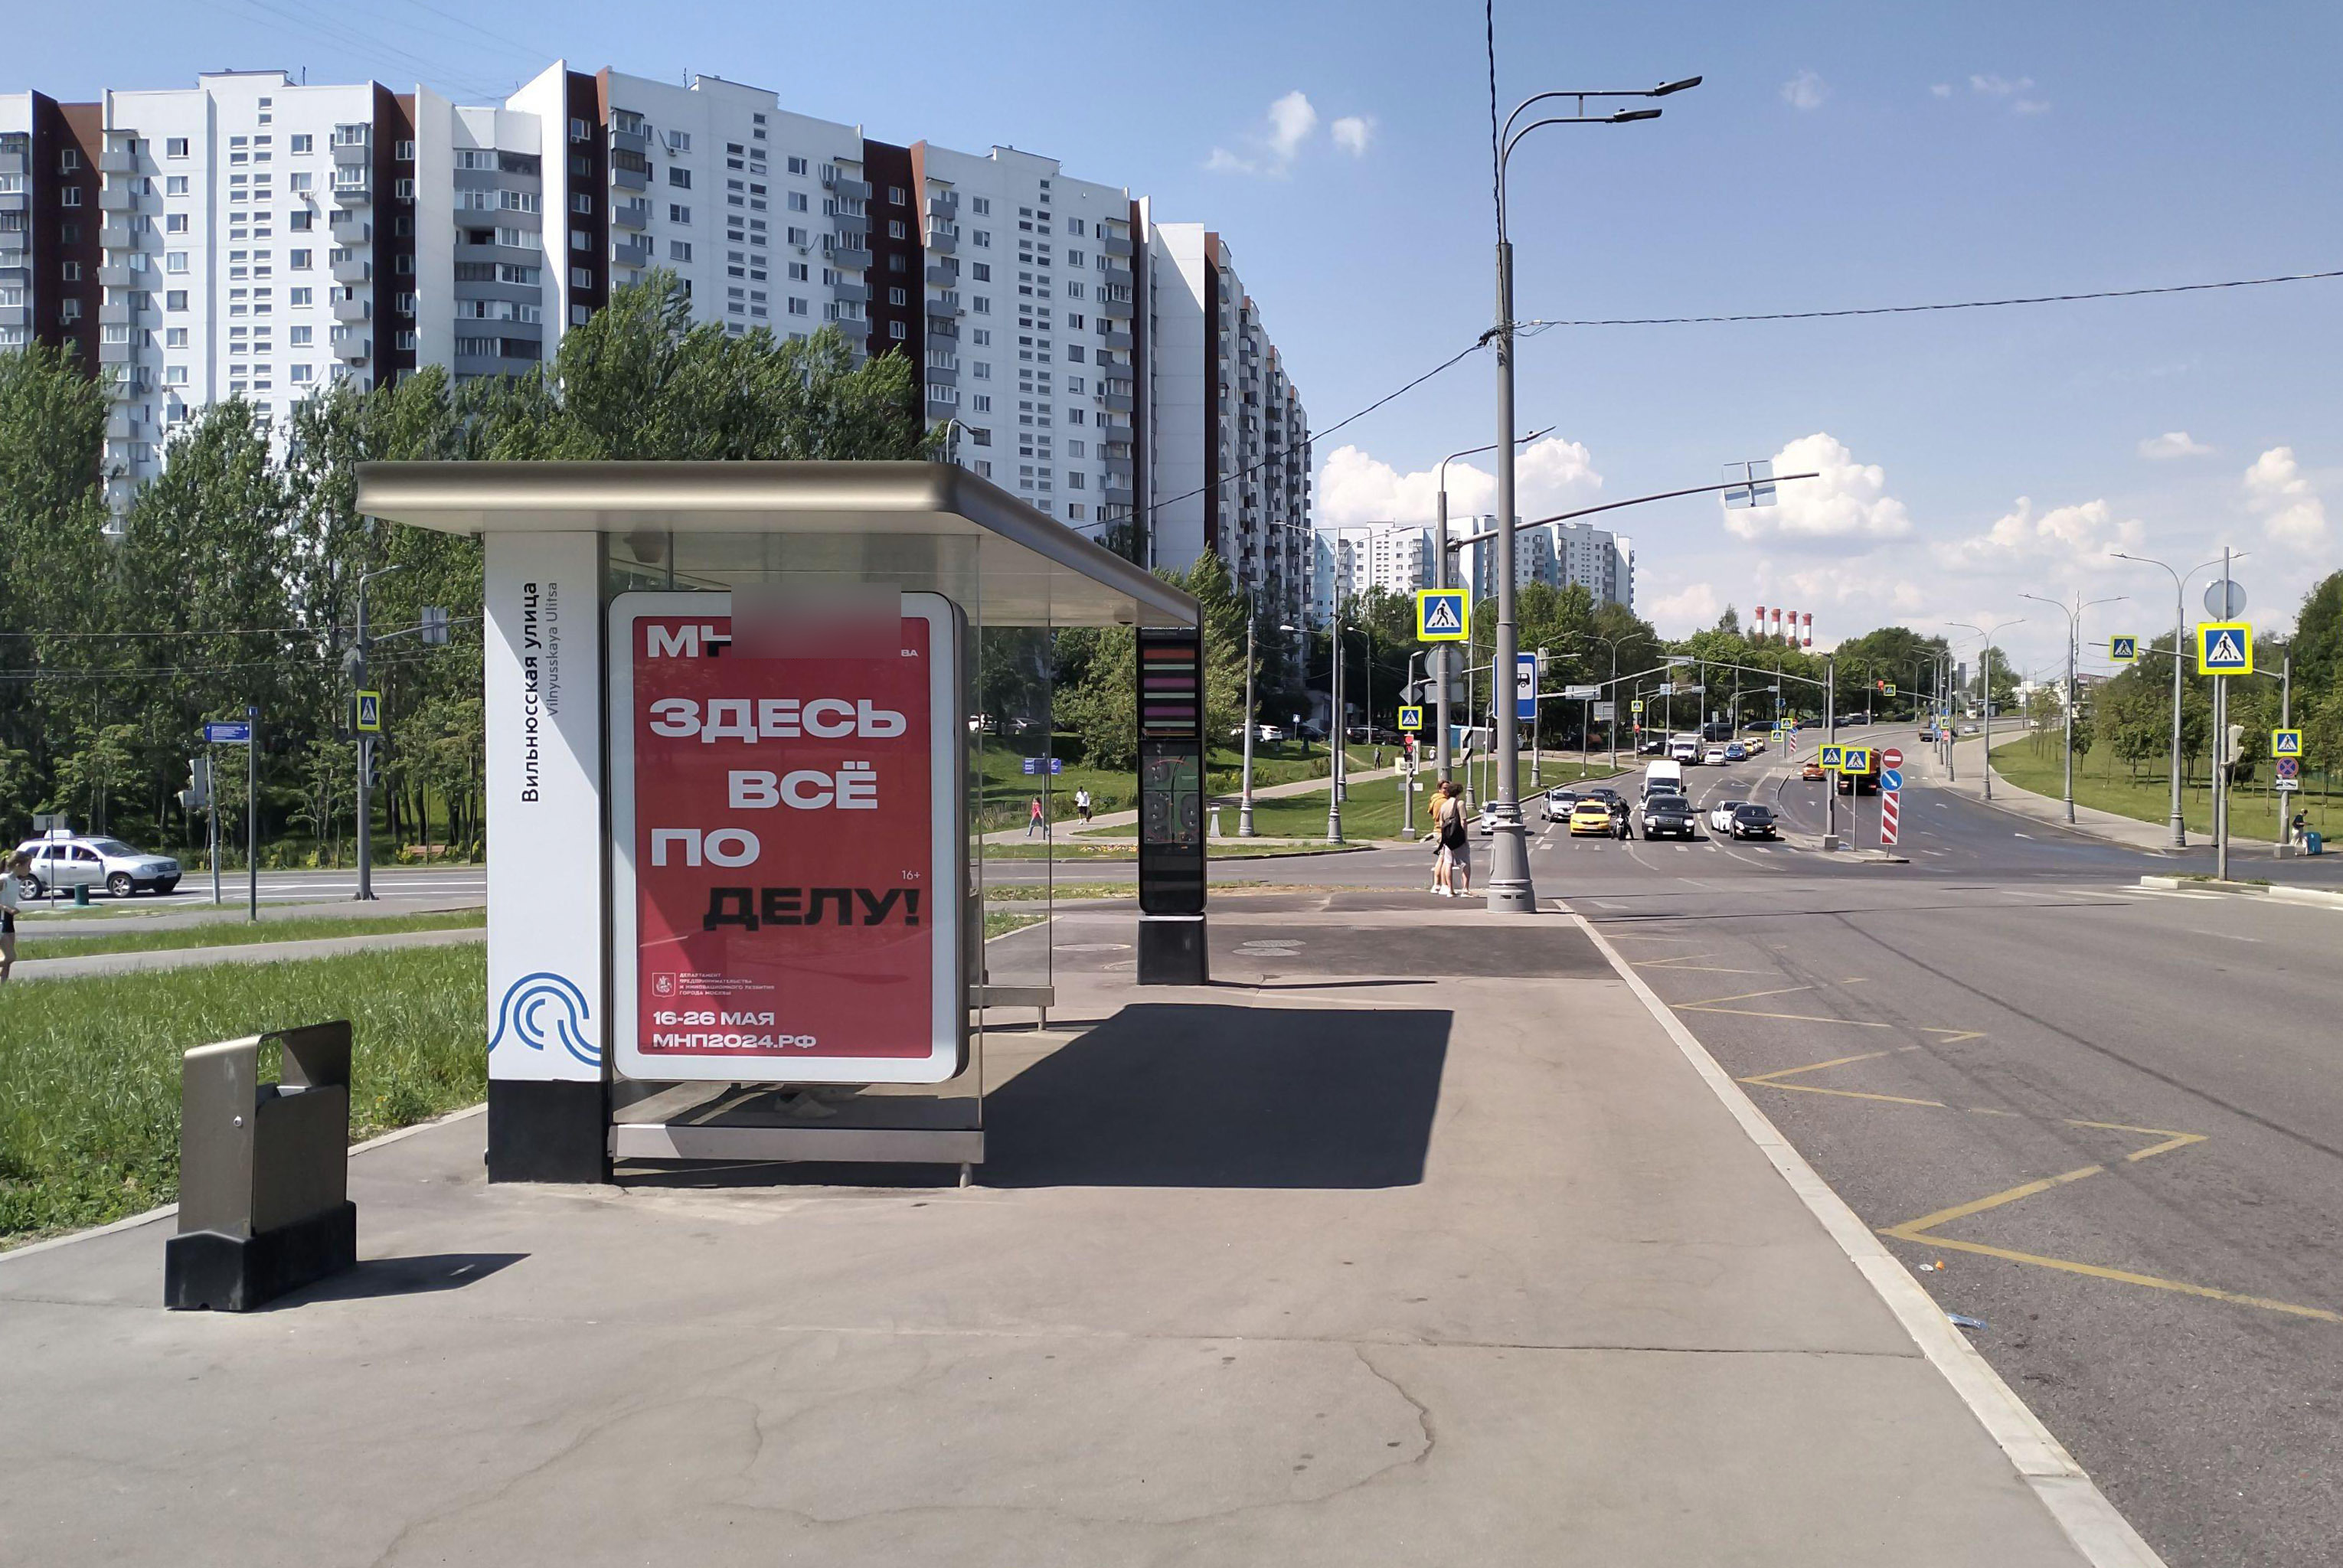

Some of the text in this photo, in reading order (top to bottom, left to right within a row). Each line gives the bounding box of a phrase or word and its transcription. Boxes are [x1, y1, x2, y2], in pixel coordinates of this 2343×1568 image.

[545, 582, 561, 717] Vilnyusskaya Ulitsa
[521, 582, 541, 802] Вильнюсская улица
[649, 697, 907, 743] ЗДЕСЬ
[727, 761, 878, 809] ВСЁ
[651, 828, 760, 867] ПО
[901, 870, 921, 880] 16+
[703, 887, 920, 932] ДЕЛУ!
[653, 1011, 775, 1026] 16-26 МАЯ
[653, 1033, 817, 1049] МНП2024.РФ
